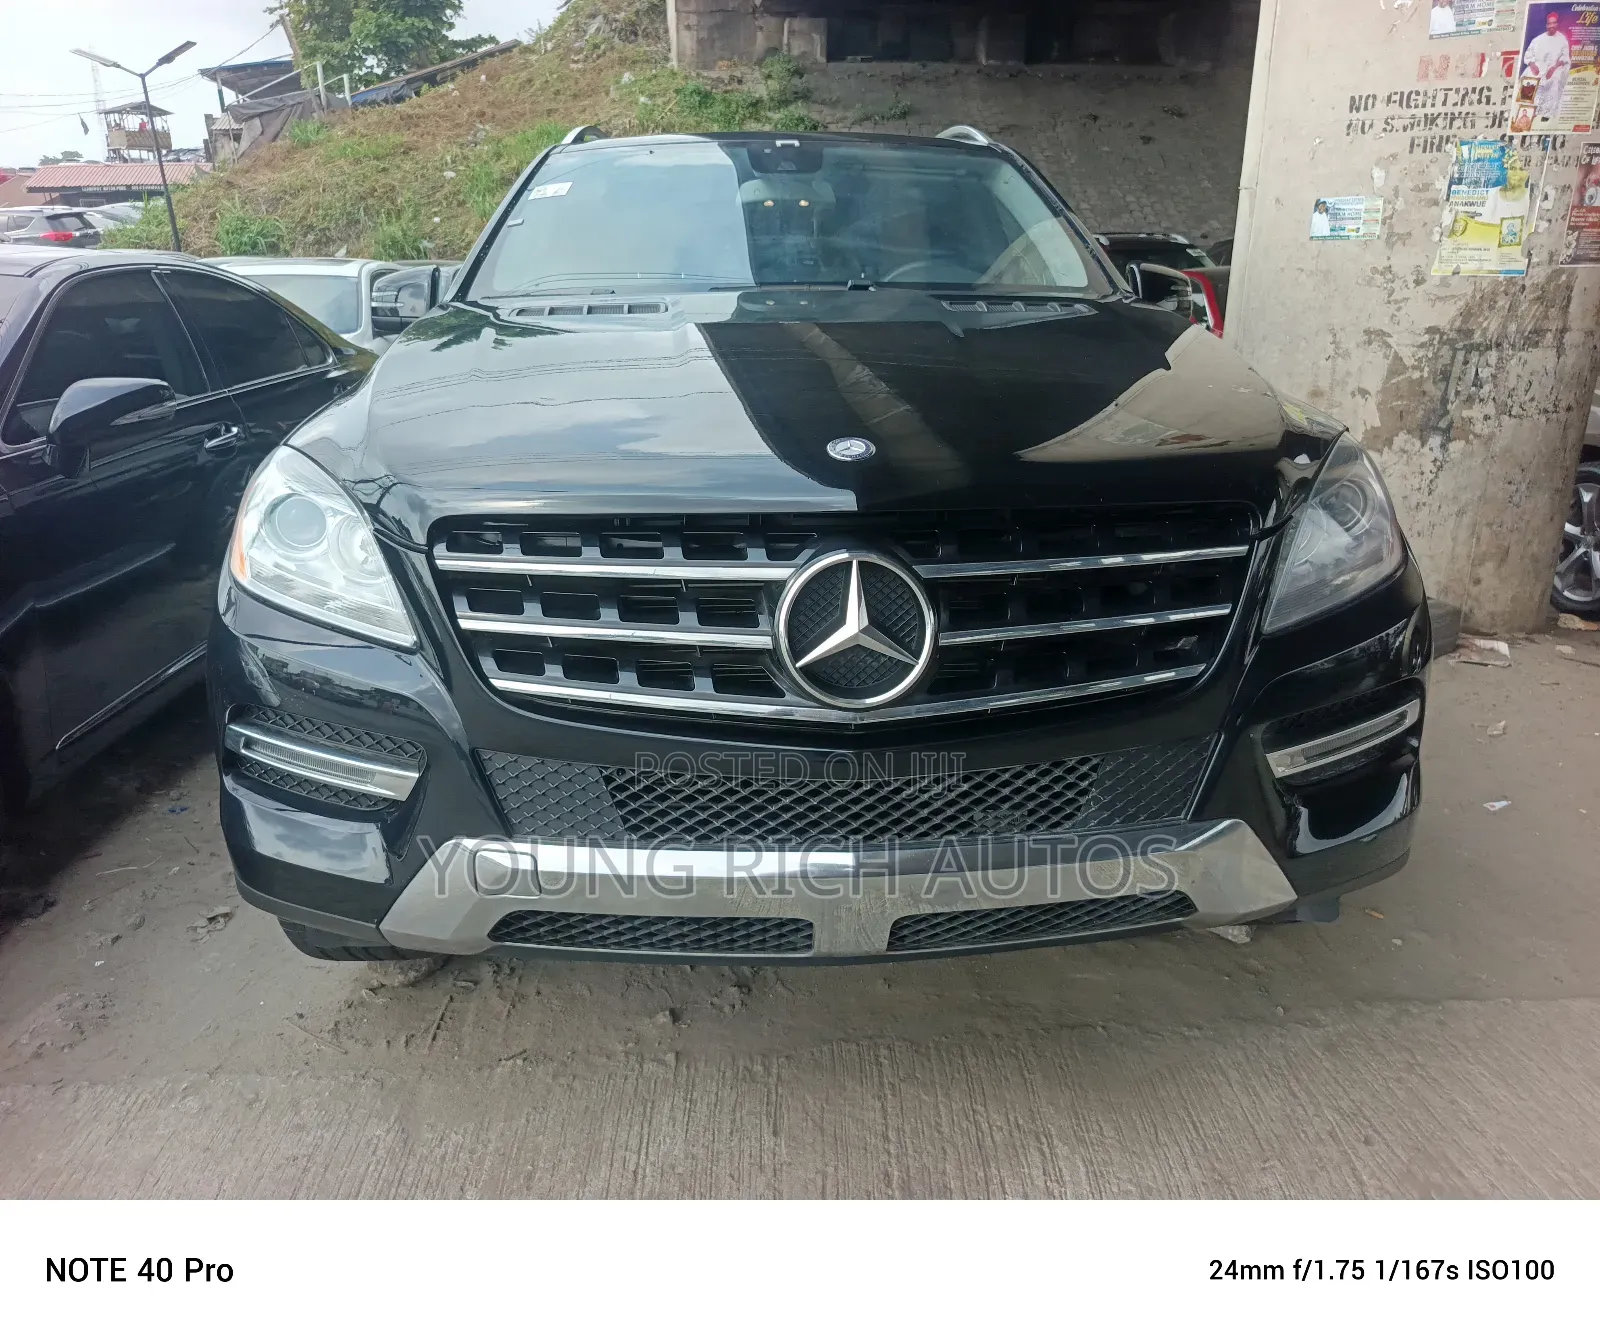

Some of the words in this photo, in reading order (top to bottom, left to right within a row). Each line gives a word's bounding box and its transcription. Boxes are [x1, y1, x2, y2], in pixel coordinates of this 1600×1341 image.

[1576, 11, 1599, 26] Life
[1348, 94, 1377, 113] NO
[1345, 118, 1374, 136] NO
